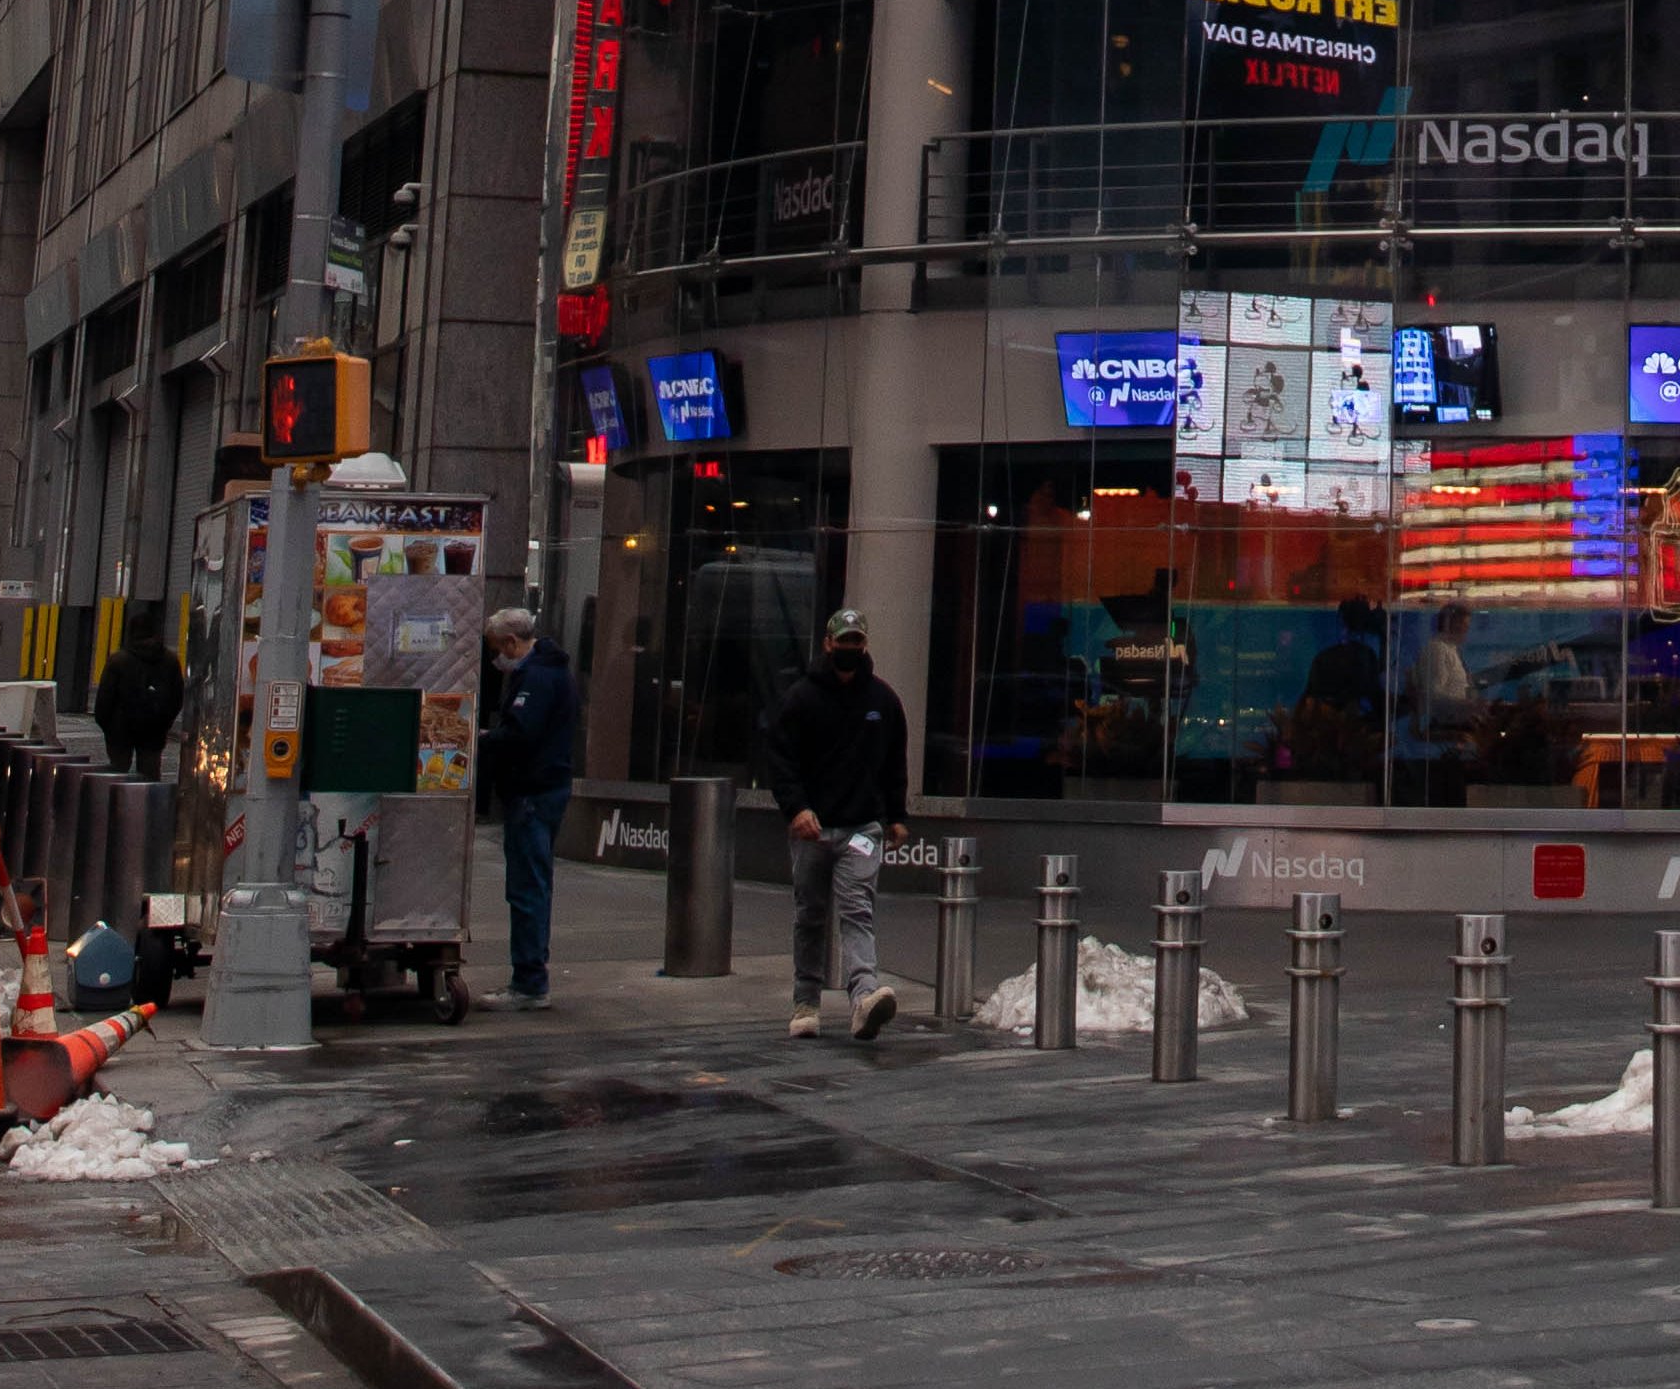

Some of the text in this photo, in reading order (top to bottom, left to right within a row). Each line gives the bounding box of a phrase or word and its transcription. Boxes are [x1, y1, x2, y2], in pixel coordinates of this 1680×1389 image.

[1419, 119, 1649, 177] Nasdaq
[316, 501, 453, 526] EAKFAST
[619, 821, 670, 858] Nasdaq
[879, 837, 939, 865] asda
[1251, 847, 1365, 885] Nasdaq
